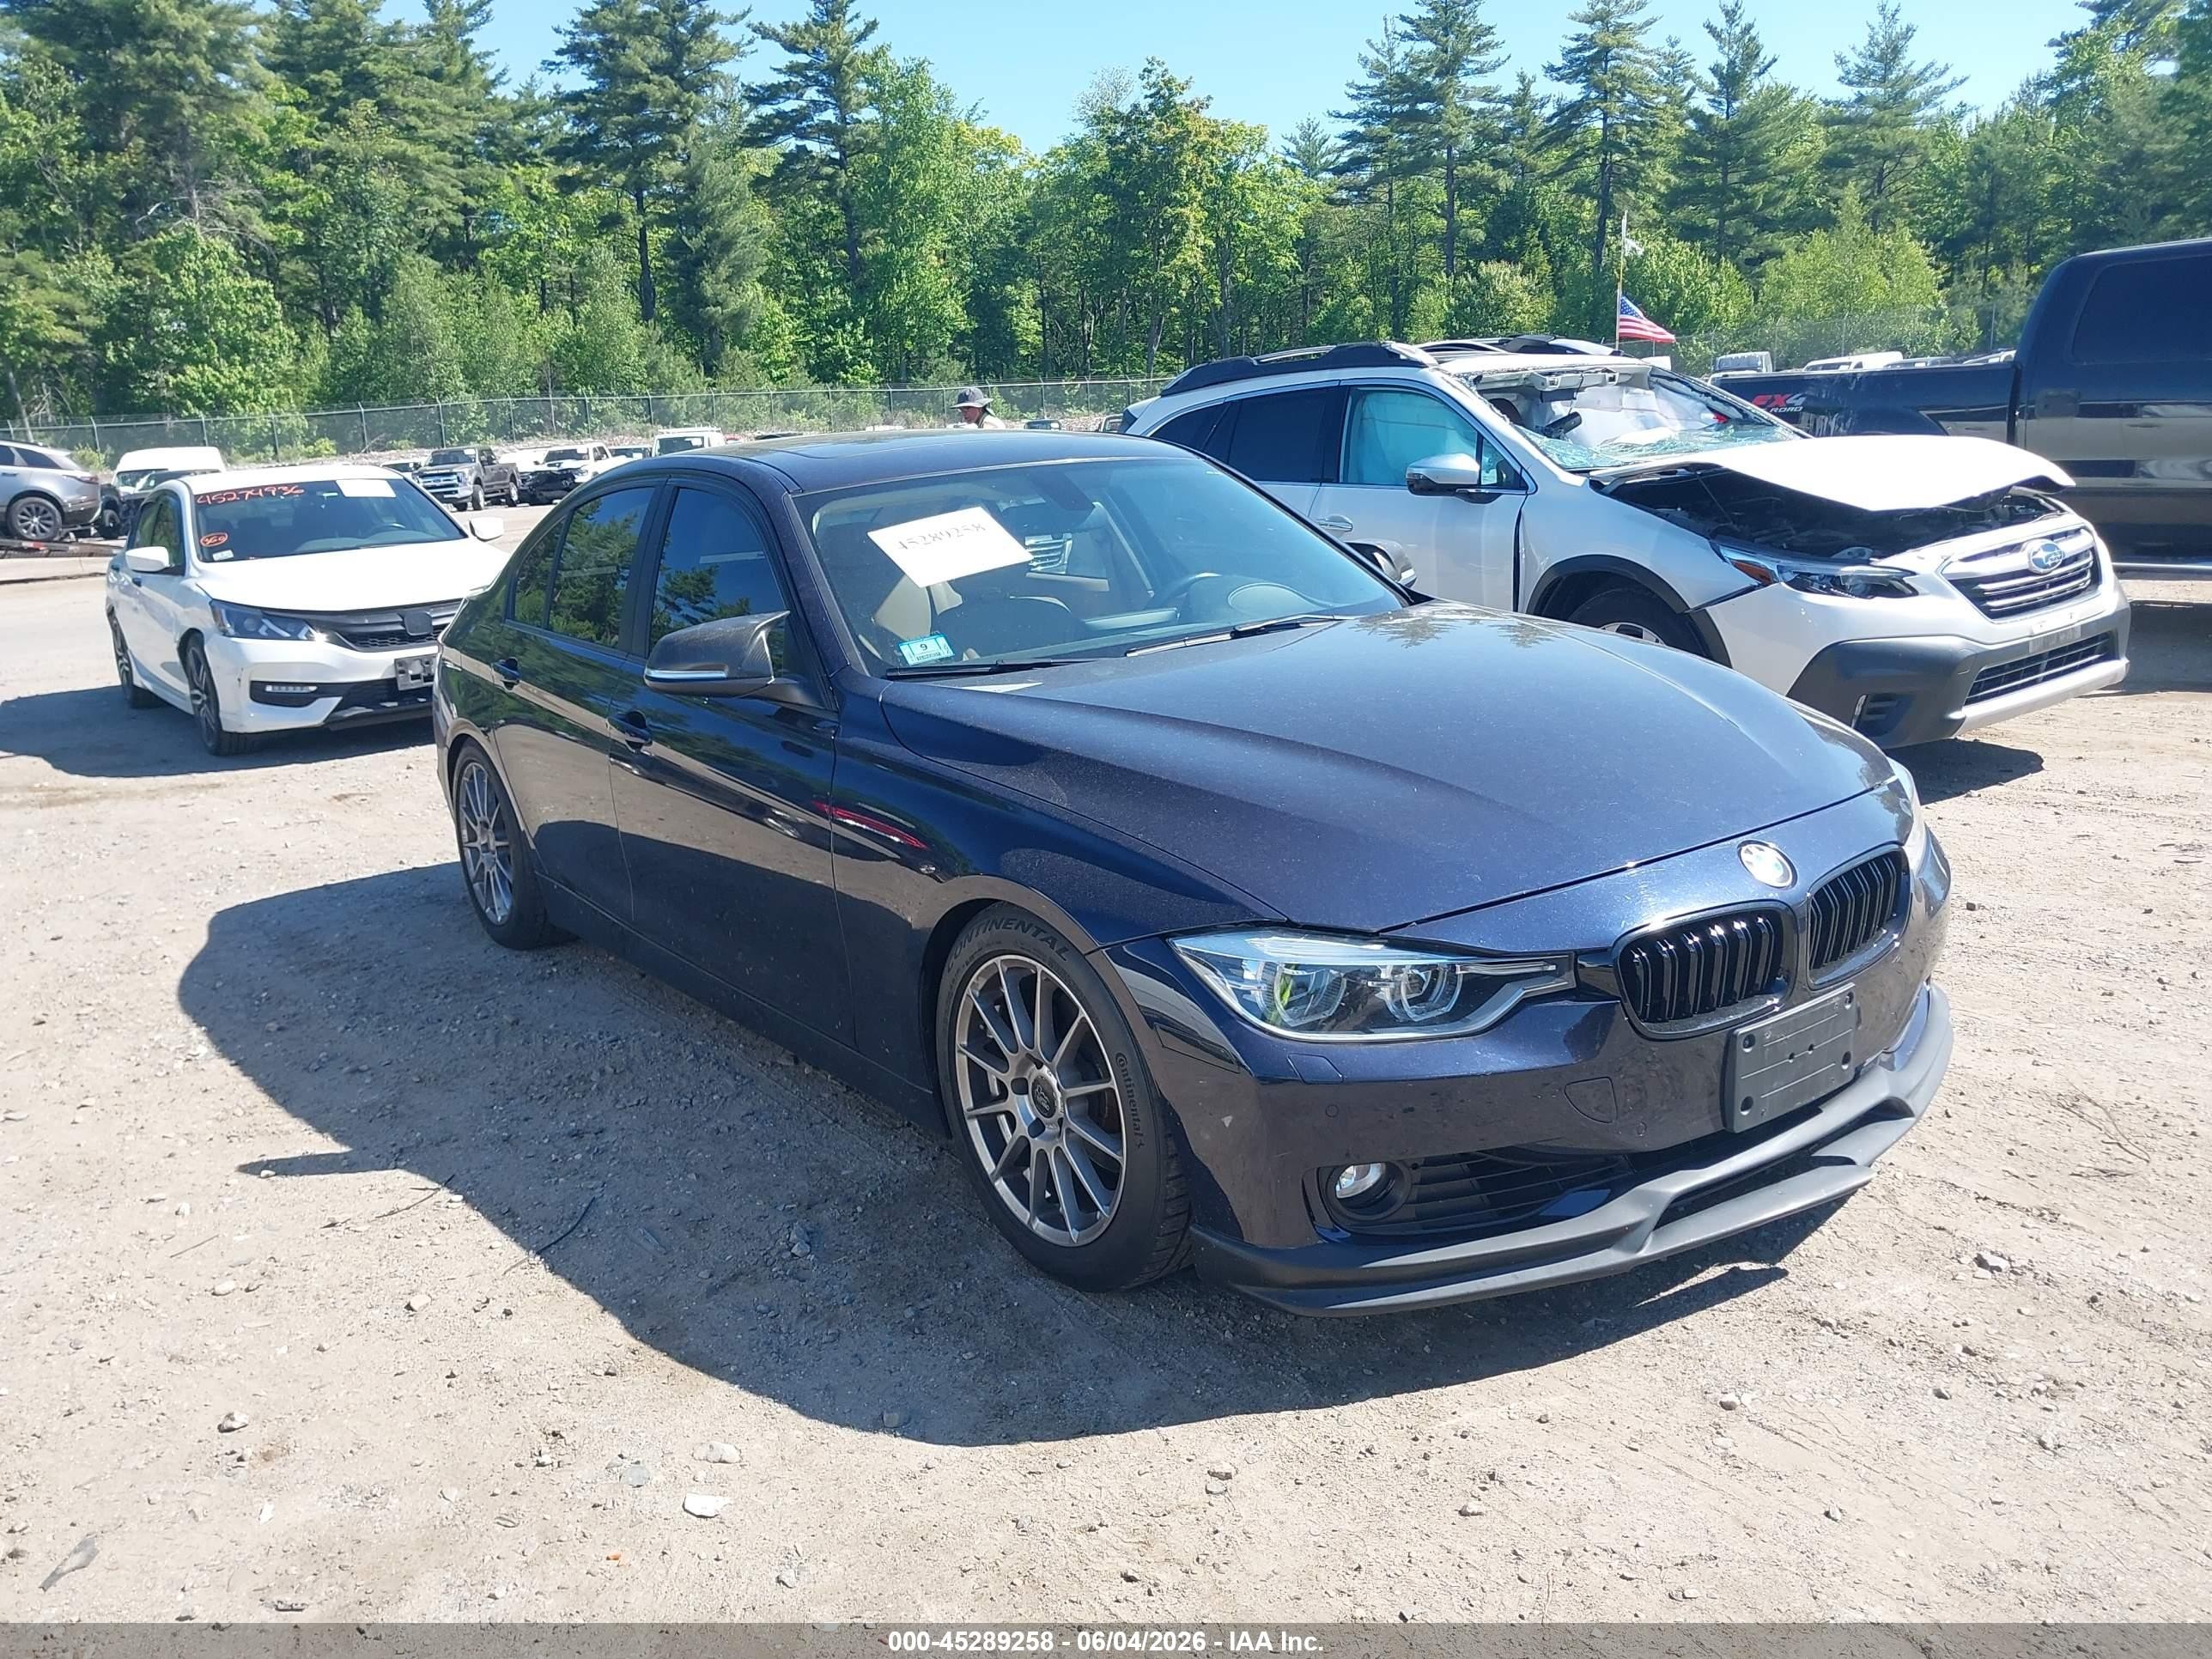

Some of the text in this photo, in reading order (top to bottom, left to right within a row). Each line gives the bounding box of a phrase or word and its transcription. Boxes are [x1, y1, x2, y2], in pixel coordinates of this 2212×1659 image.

[1752, 393, 1807, 407] FX4
[946, 917, 1071, 973] CONTINENTAL
[1115, 1052, 1144, 1138] Continental
